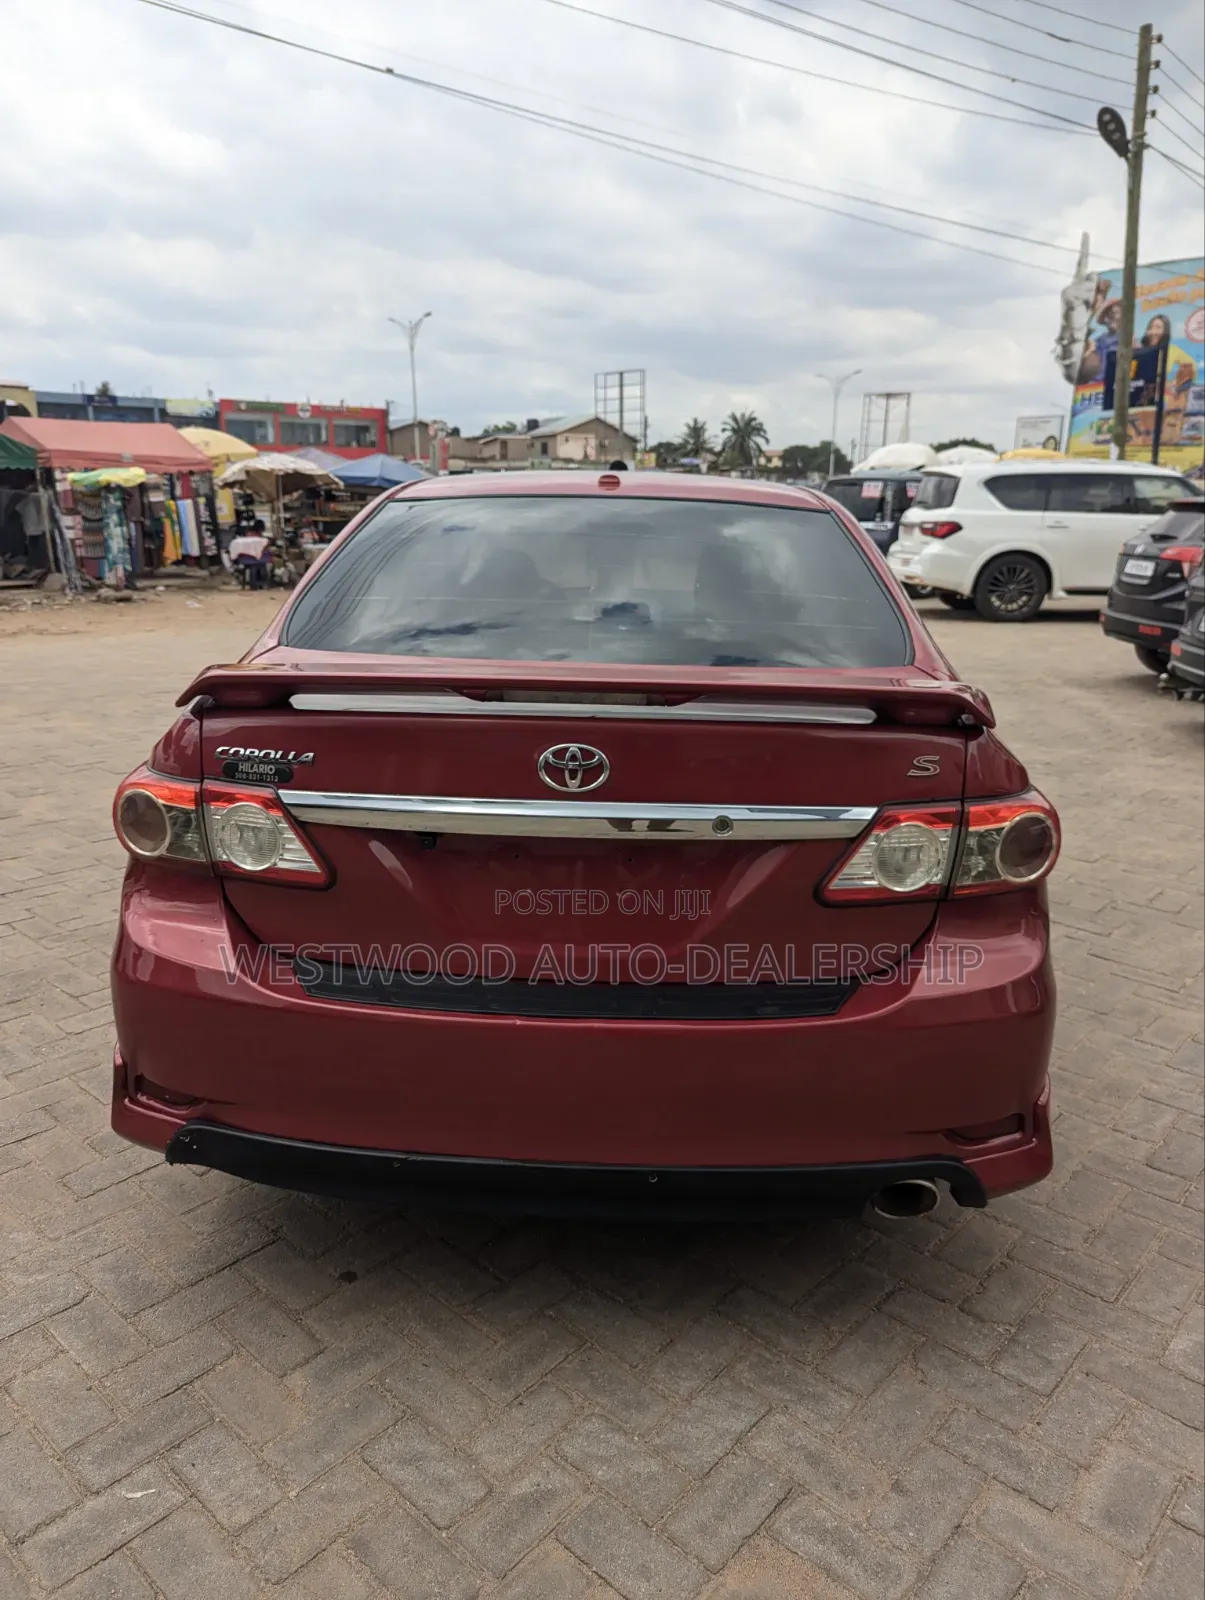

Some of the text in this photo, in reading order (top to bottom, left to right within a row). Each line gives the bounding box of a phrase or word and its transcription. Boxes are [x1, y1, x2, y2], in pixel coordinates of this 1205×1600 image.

[214, 746, 315, 765] COROLLA
[238, 762, 276, 774] HILARIO
[906, 755, 940, 776] S
